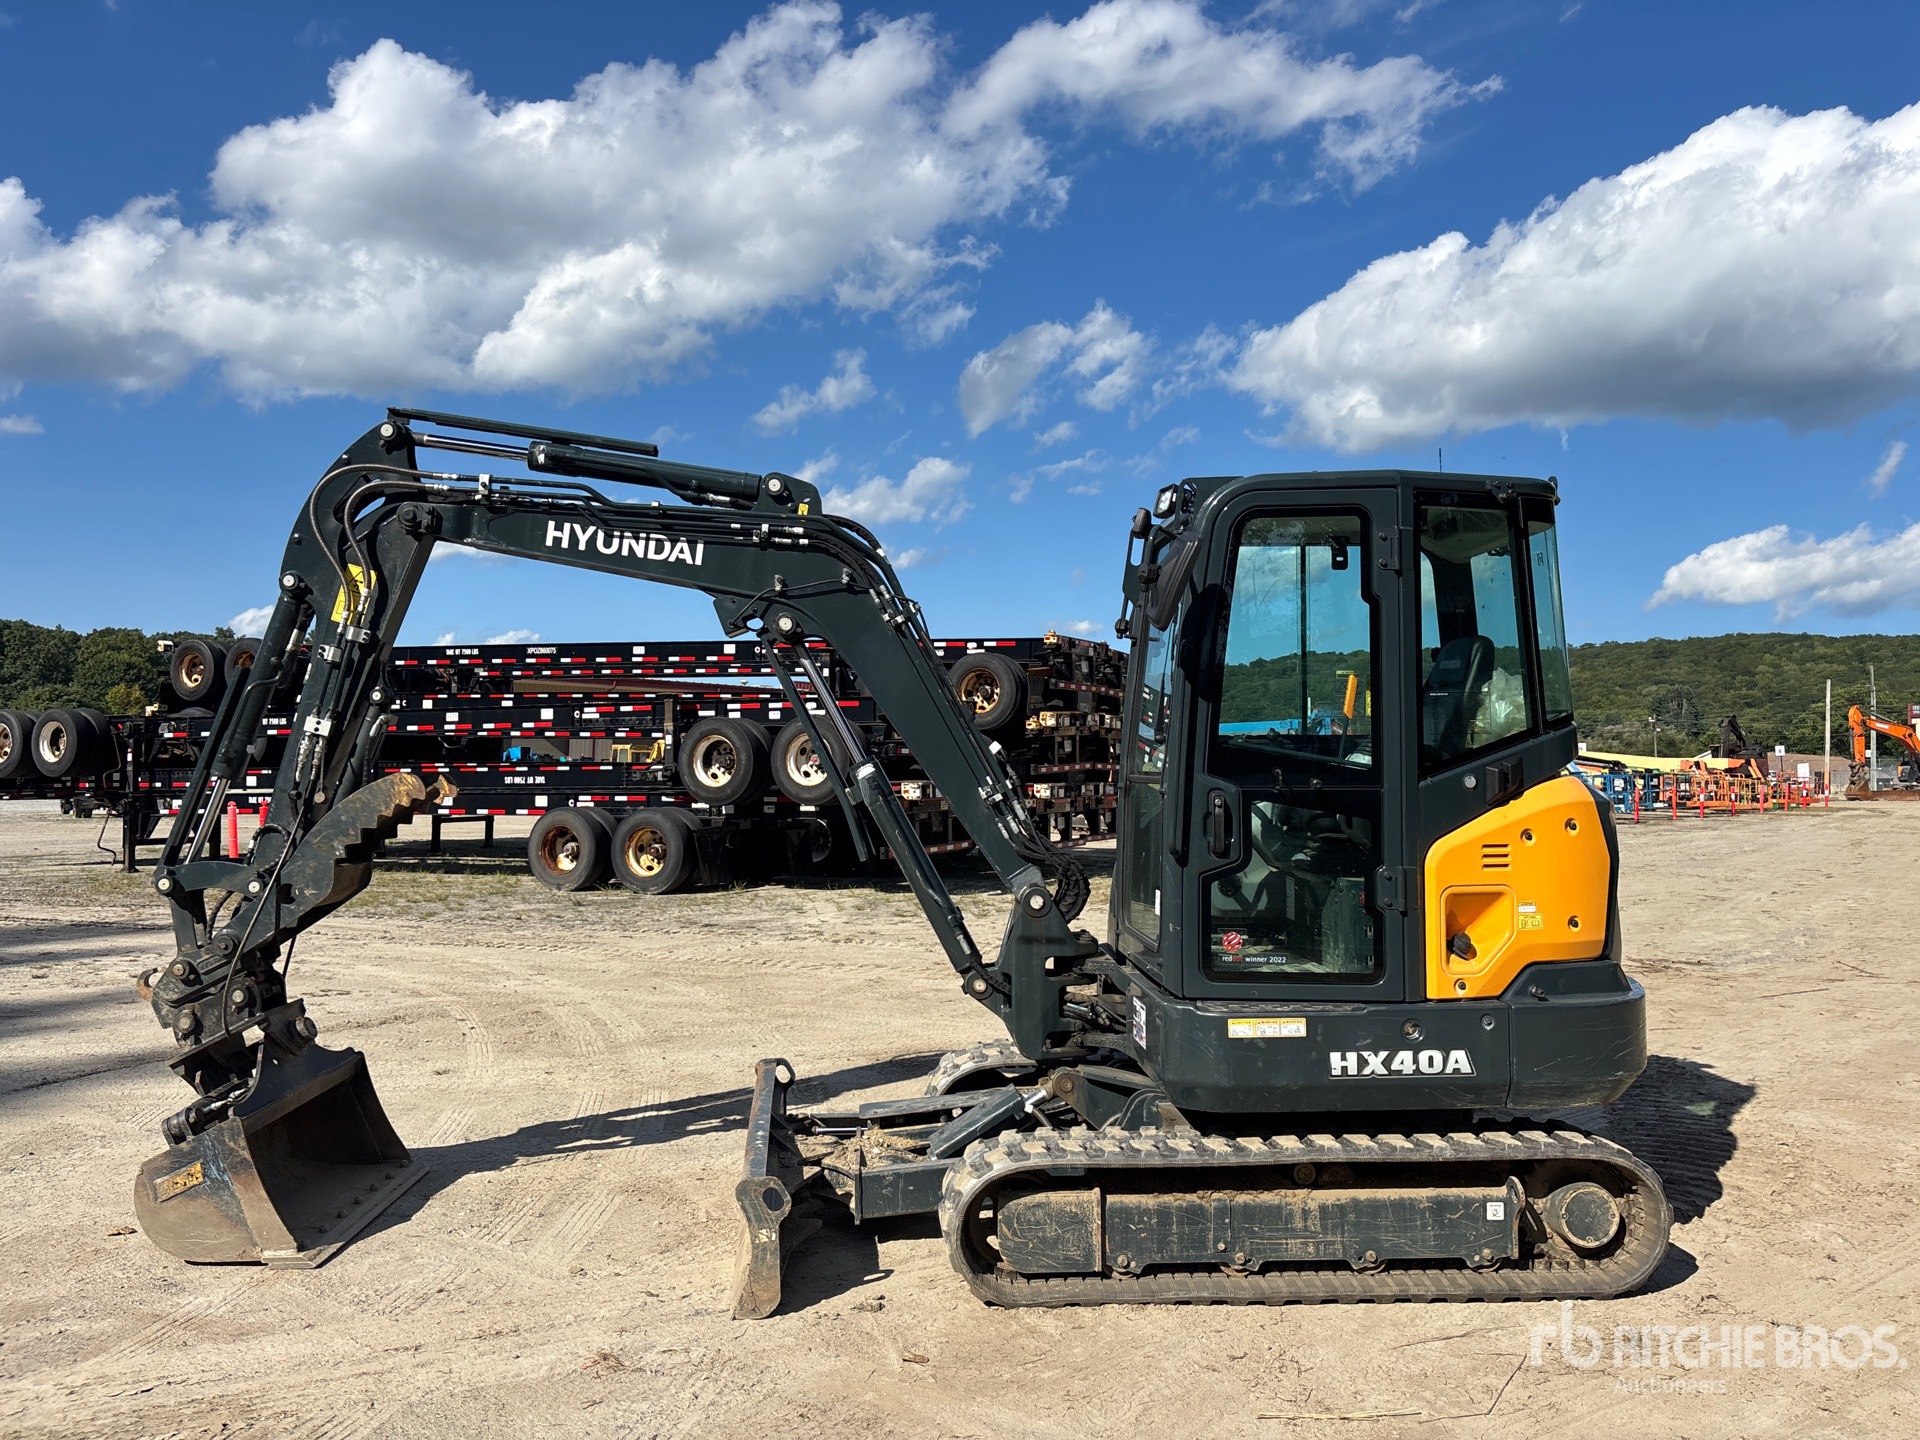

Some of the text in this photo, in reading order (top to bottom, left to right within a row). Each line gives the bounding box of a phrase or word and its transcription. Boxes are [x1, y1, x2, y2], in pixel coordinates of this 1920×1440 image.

[545, 520, 704, 566] HYUNDAI
[1244, 955, 1268, 963] winner
[1329, 1049, 1473, 1076] HX40A
